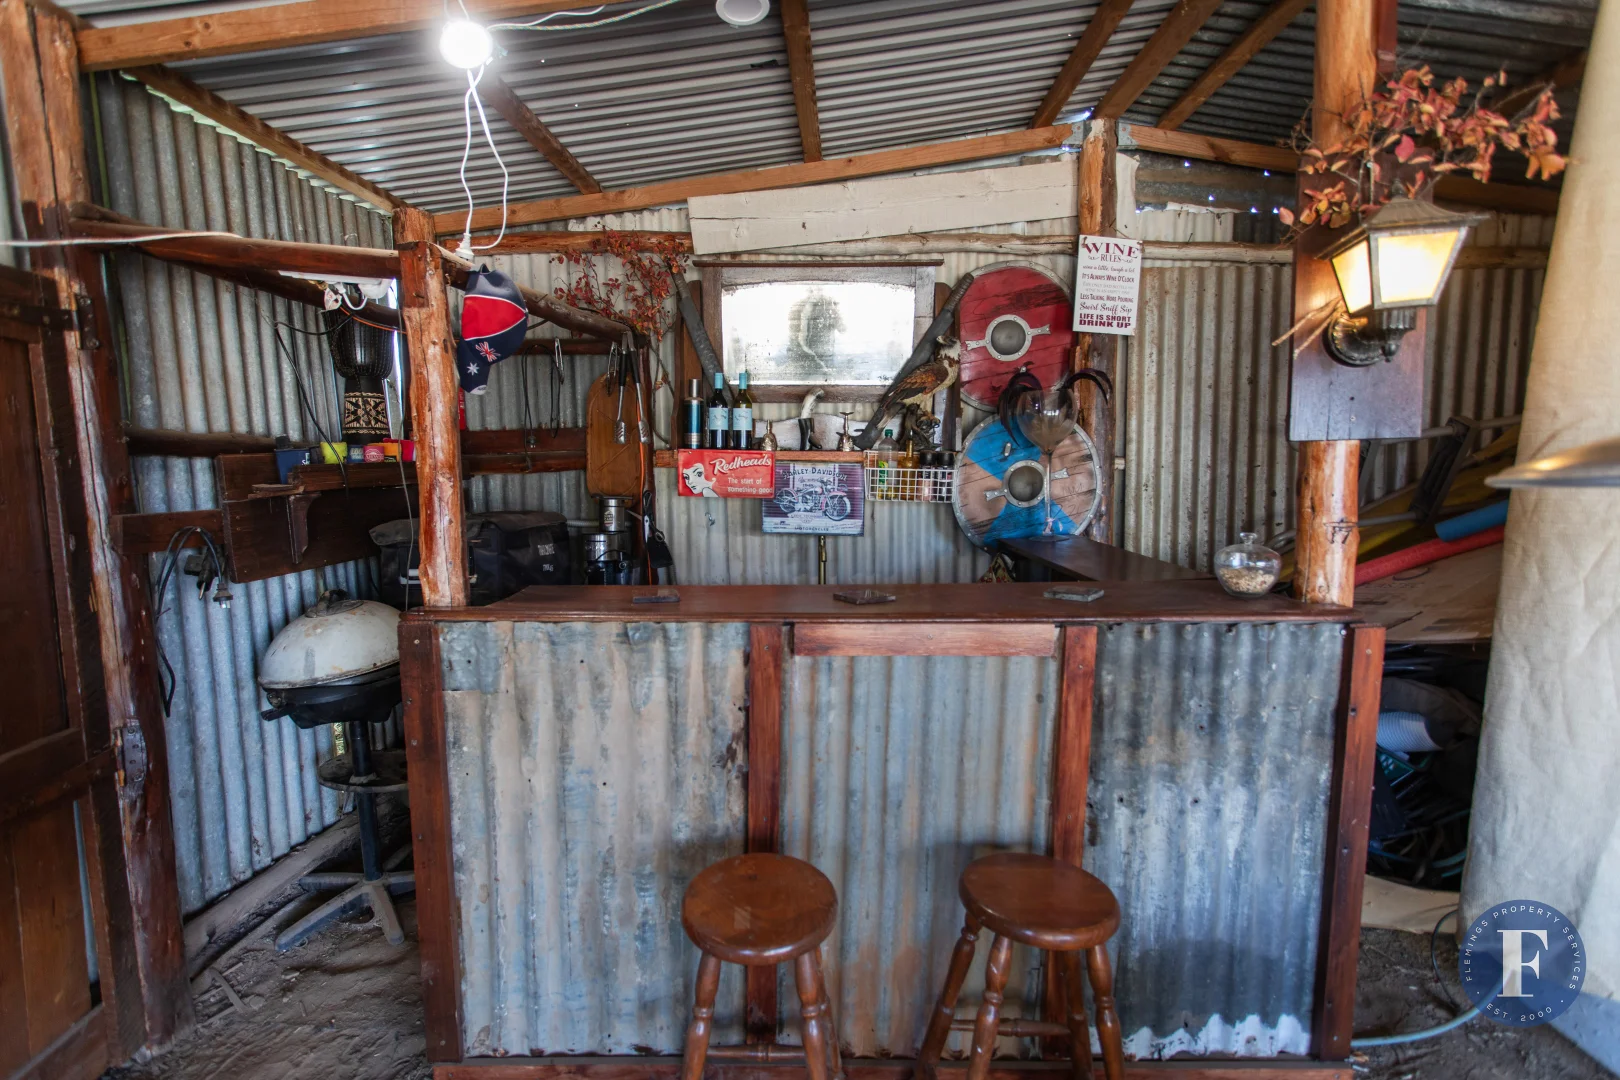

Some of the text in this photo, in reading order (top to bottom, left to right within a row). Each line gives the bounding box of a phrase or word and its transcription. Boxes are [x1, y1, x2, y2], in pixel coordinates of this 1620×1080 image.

[1082, 242, 1139, 259] WINE
[1100, 254, 1122, 263] RULES
[1080, 301, 1132, 316] Swirl Sniff Sip
[1106, 314, 1131, 322] SHORT
[1078, 320, 1114, 328] DRINK
[710, 454, 772, 475] Redheads
[728, 486, 757, 494] something
